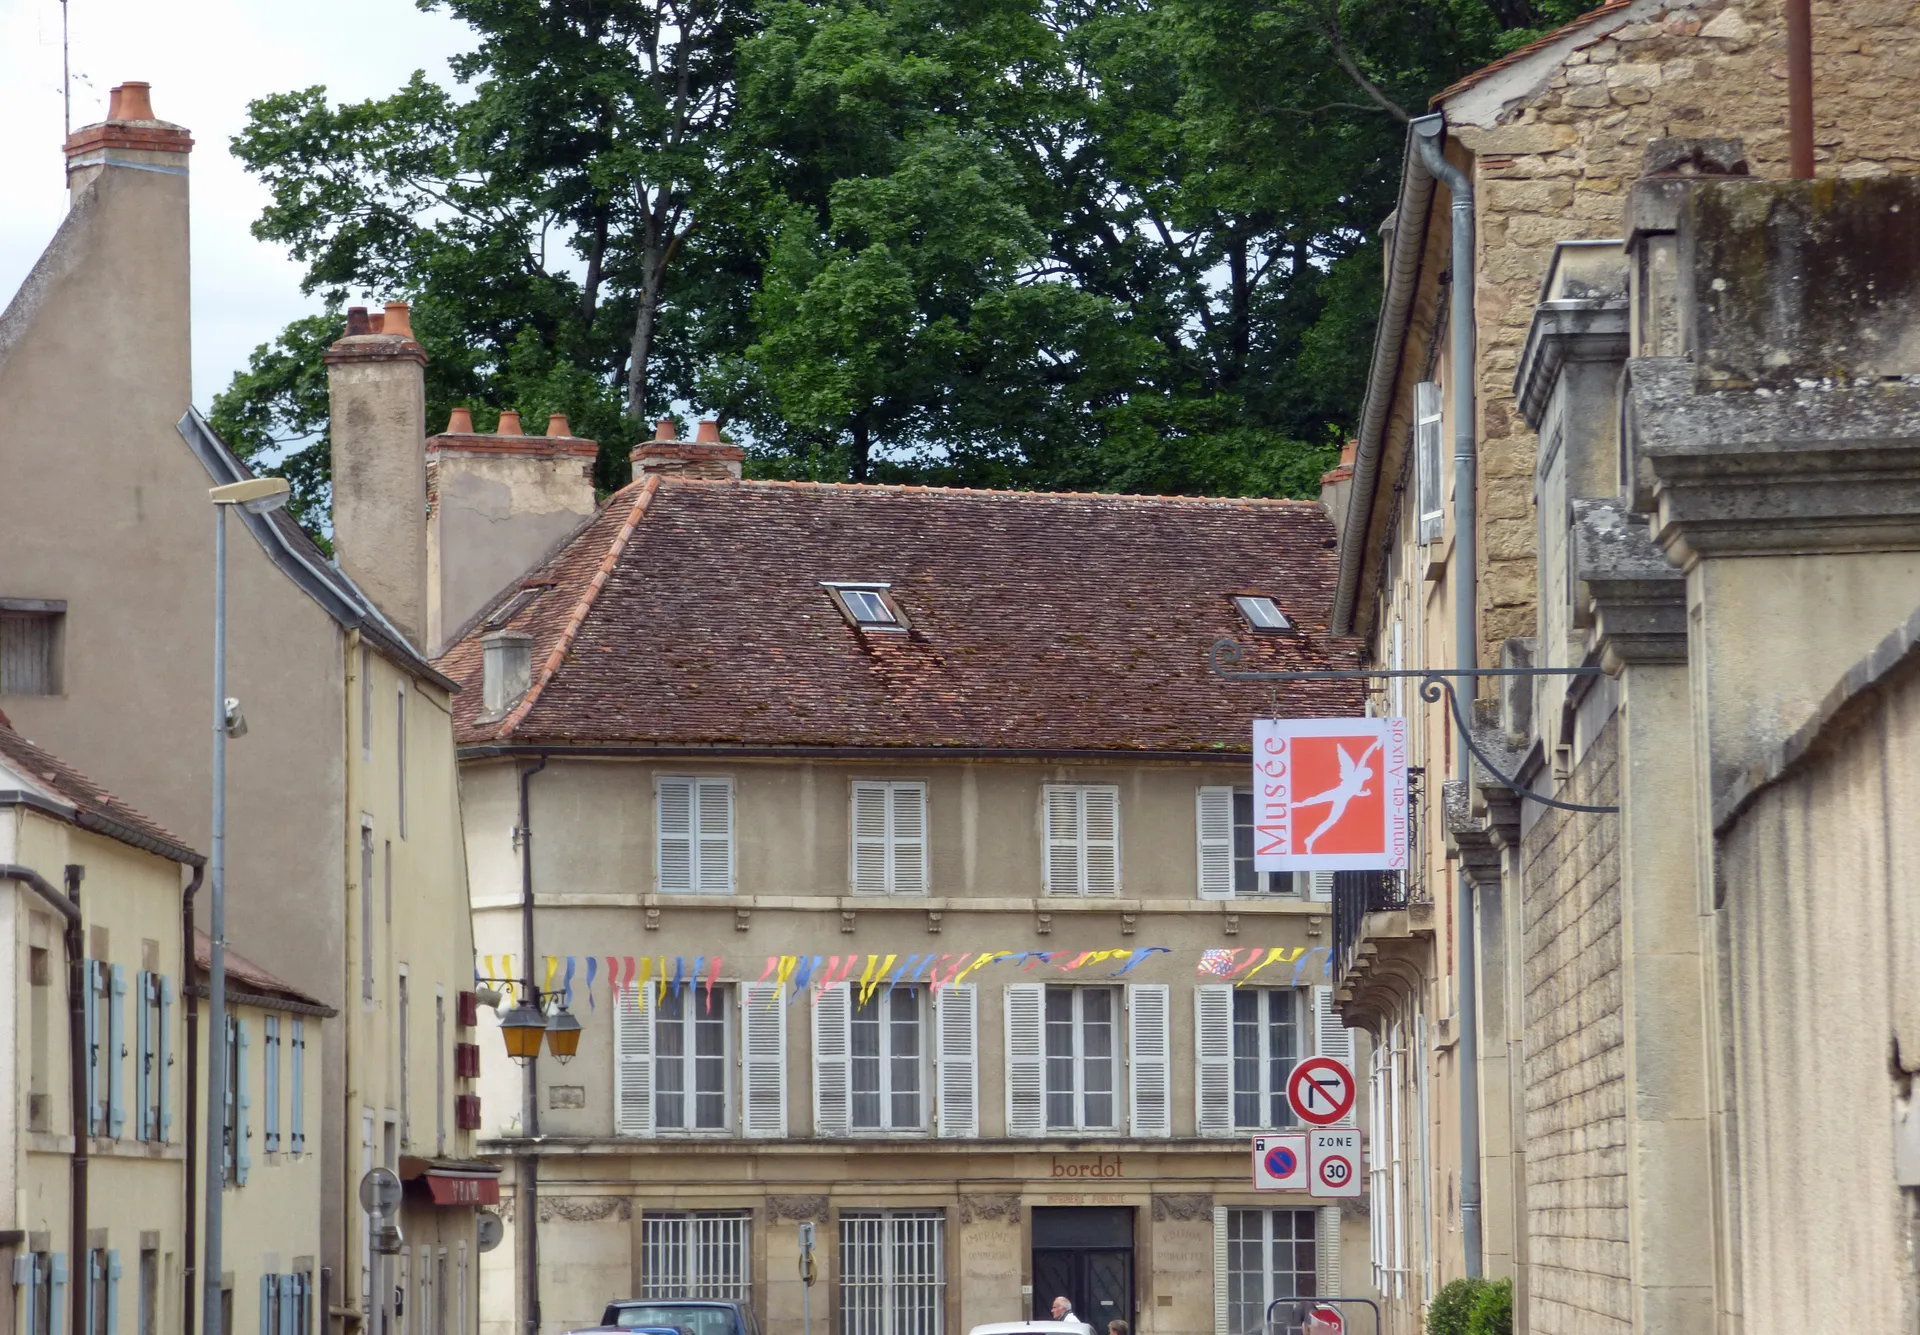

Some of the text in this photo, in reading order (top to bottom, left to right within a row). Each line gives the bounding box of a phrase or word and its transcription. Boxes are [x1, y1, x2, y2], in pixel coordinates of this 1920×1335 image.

[1256, 737, 1287, 856] Musée
[1388, 720, 1405, 868] Semur-en-Auxois
[1318, 1137, 1352, 1147] ZONE
[1050, 1154, 1124, 1178] bordot
[1326, 1164, 1346, 1179] 30
